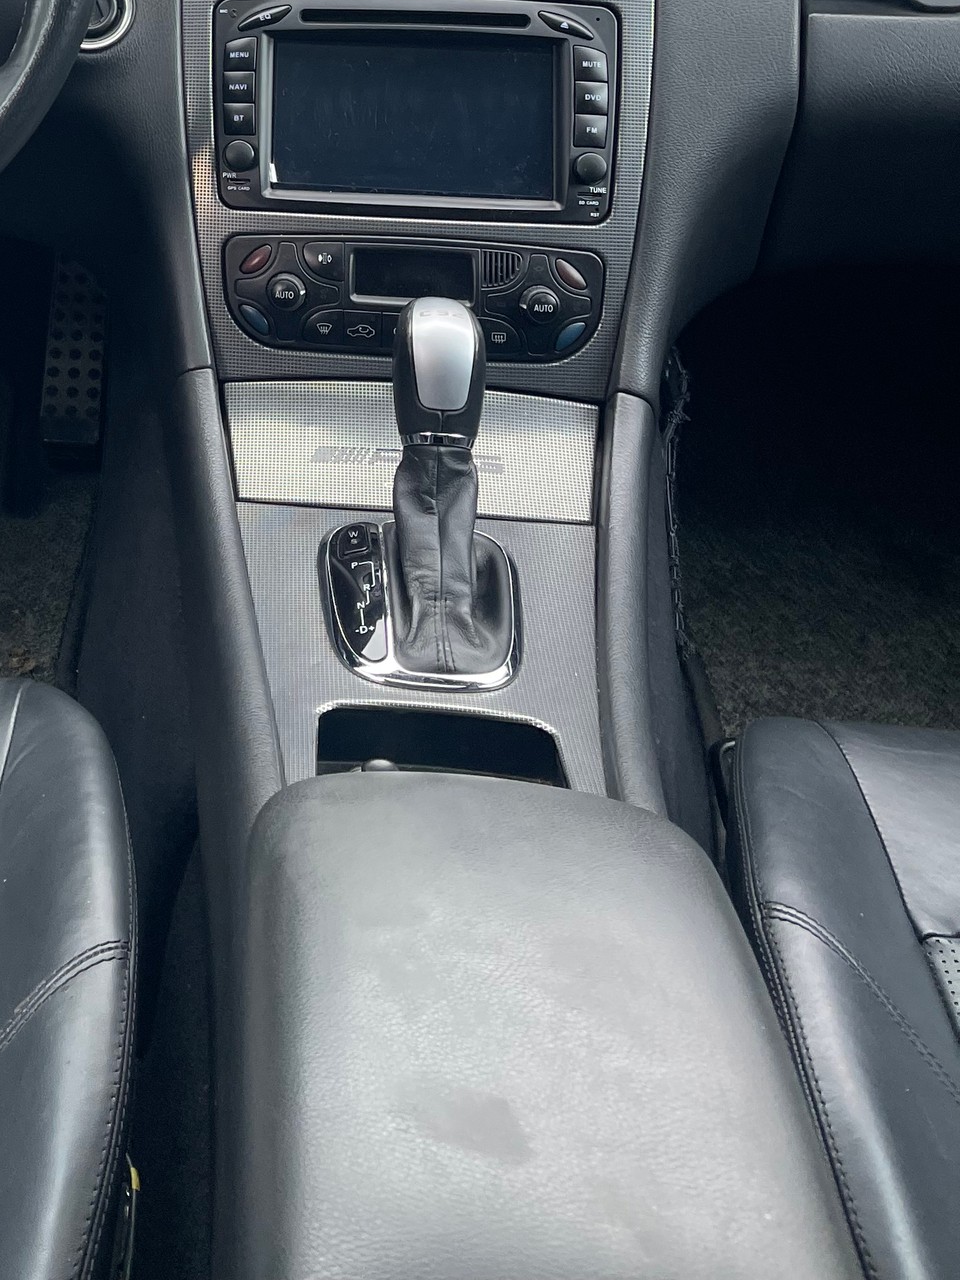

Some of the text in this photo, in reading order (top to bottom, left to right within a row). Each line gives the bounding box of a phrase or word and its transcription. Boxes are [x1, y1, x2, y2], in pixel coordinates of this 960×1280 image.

[259, 12, 272, 21] EQ
[582, 60, 602, 68] MUTE
[584, 93, 601, 101] DVD
[233, 114, 245, 122] BT
[586, 126, 598, 134] FM
[222, 171, 237, 179] PWR
[589, 186, 607, 194] TUNE
[274, 290, 294, 300] AUTO
[533, 303, 553, 313] AUTO
